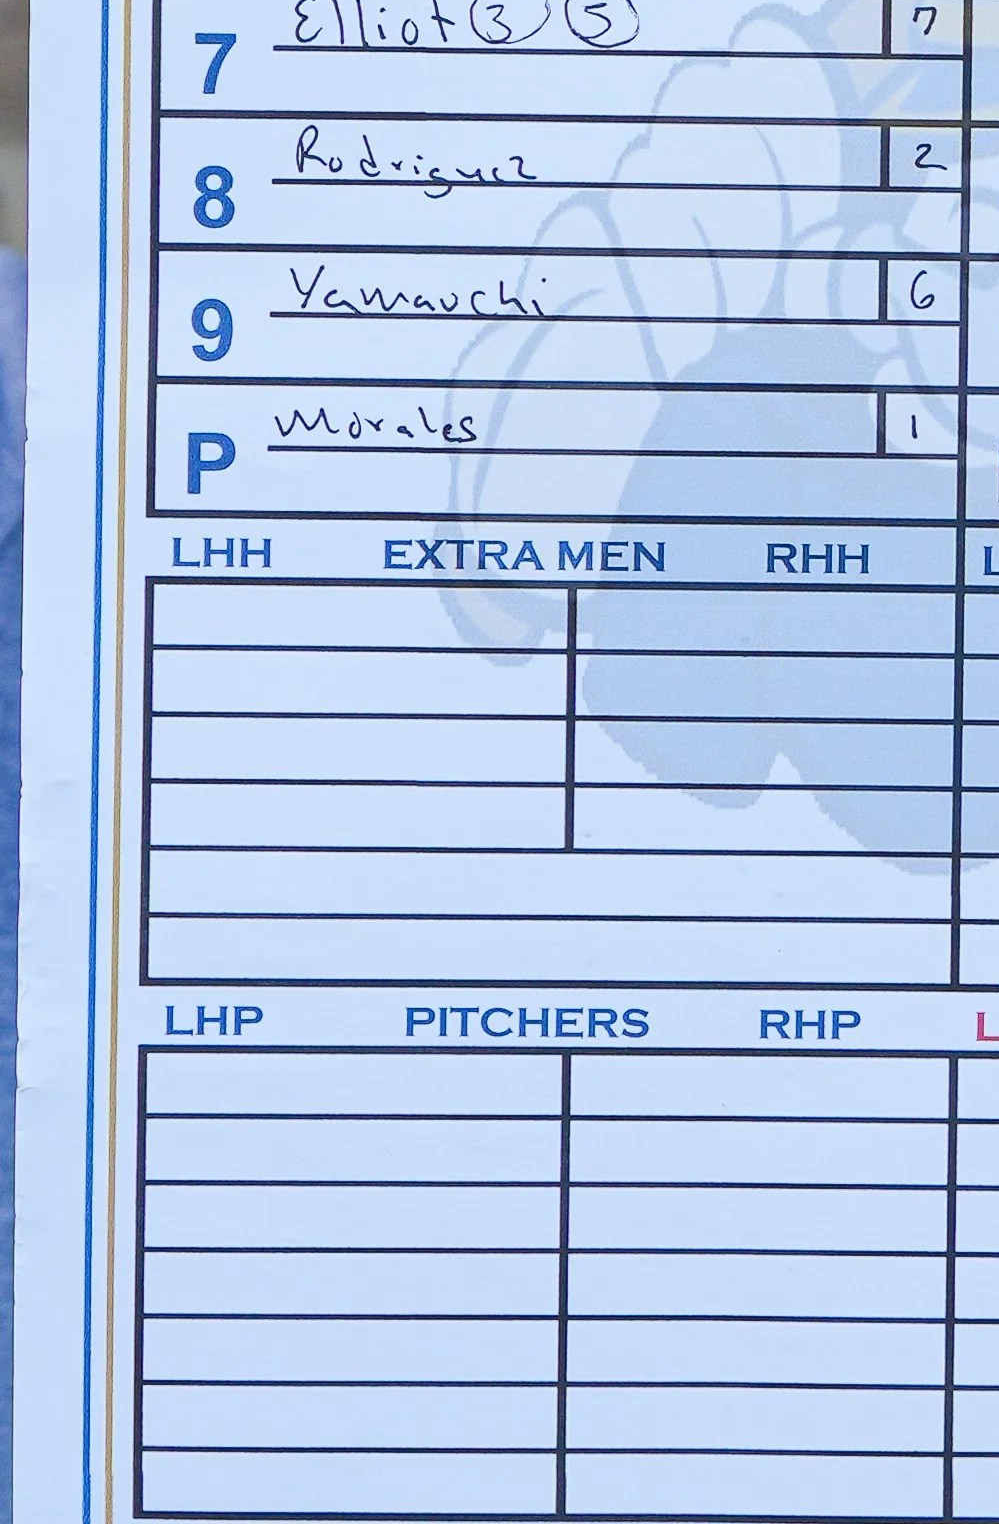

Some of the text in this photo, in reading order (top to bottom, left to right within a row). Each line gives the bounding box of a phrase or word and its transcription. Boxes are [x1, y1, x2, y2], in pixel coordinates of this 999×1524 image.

[913, 7, 937, 37] 7
[194, 32, 237, 95] 7
[916, 144, 946, 170] 2
[193, 165, 236, 229] 8
[910, 270, 935, 310] 6
[191, 298, 234, 362] 9
[275, 406, 476, 443] Morales
[911, 416, 918, 439] 1
[187, 432, 236, 495] P
[172, 537, 870, 574] LHH EXTRA MEN RHH
[165, 1005, 861, 1040] LHP PITCHERS RHP
